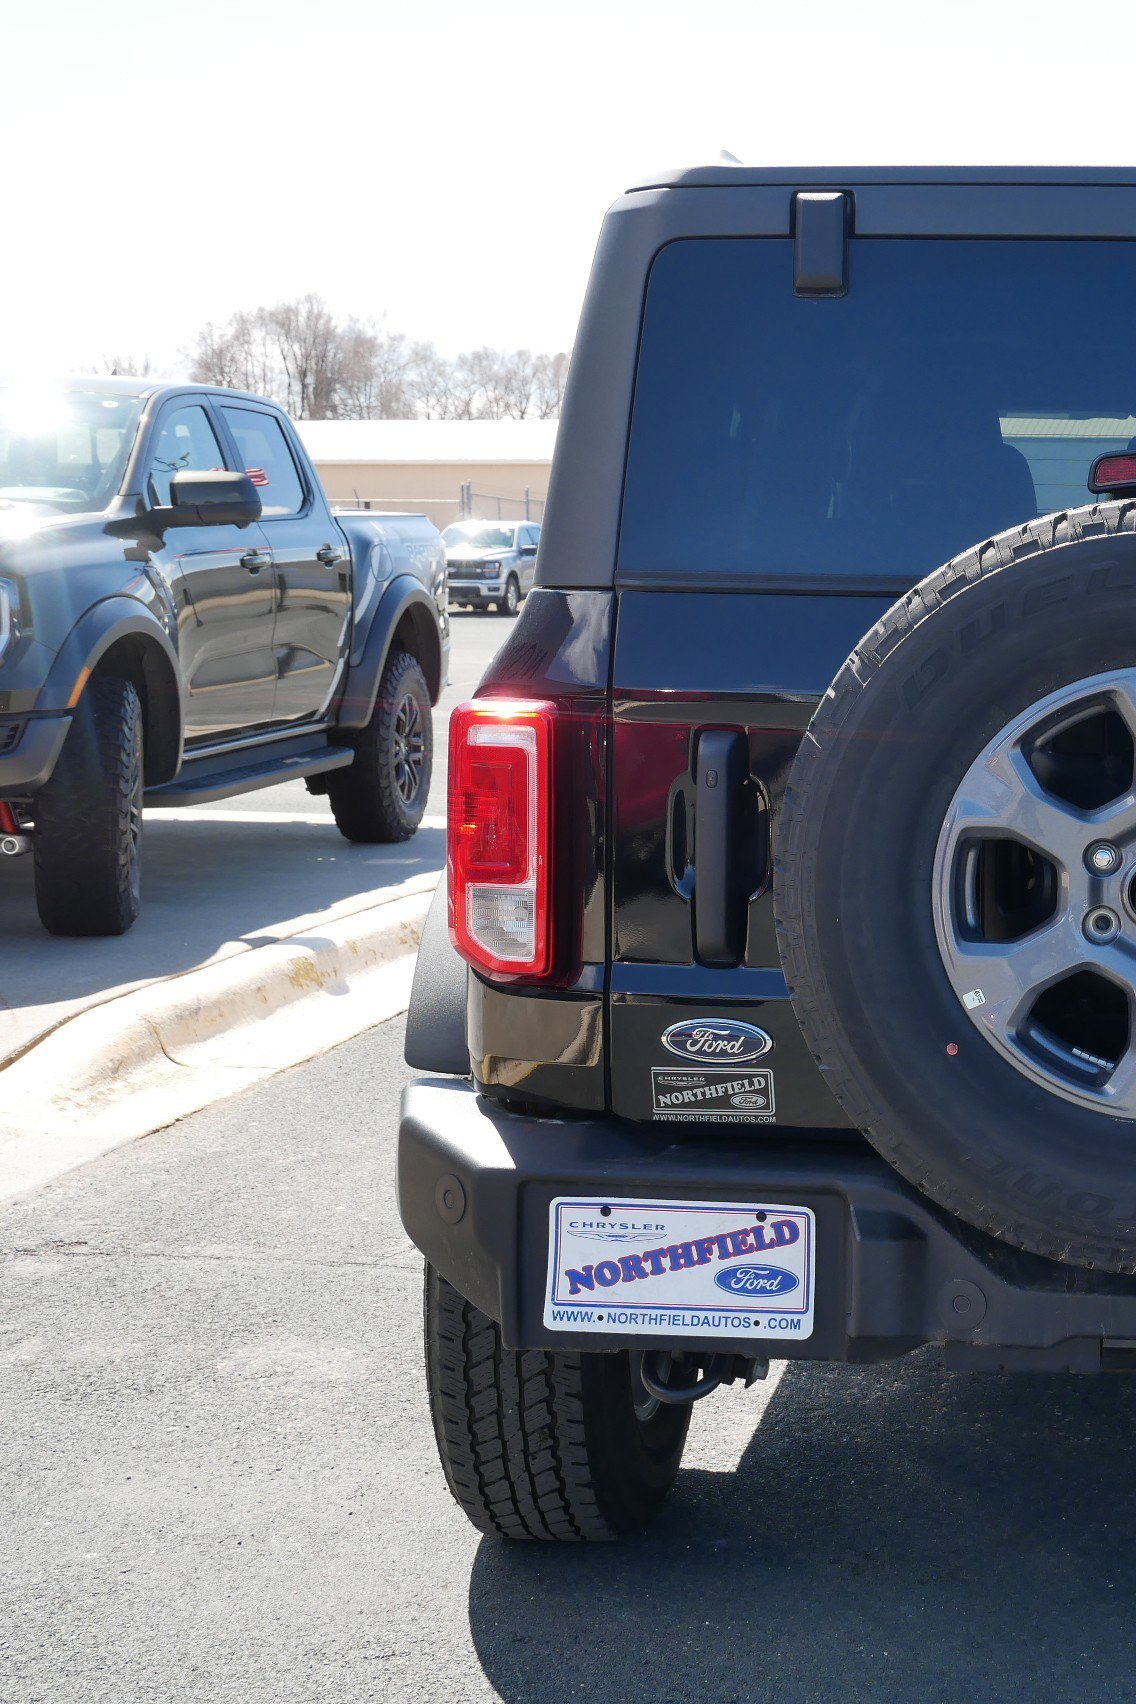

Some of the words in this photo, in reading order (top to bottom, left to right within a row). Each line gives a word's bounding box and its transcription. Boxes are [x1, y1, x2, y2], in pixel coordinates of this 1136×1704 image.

[686, 1027, 745, 1054] Ford
[657, 1076, 766, 1107] NORTHFIELD
[738, 1096, 760, 1106] Ford
[652, 1114, 777, 1123] WWW.NORTHFIELDAUTOS.COM
[568, 1221, 666, 1231] CHRYSLER
[564, 1219, 800, 1295] NORTHFIELD
[730, 1267, 783, 1291] Ford
